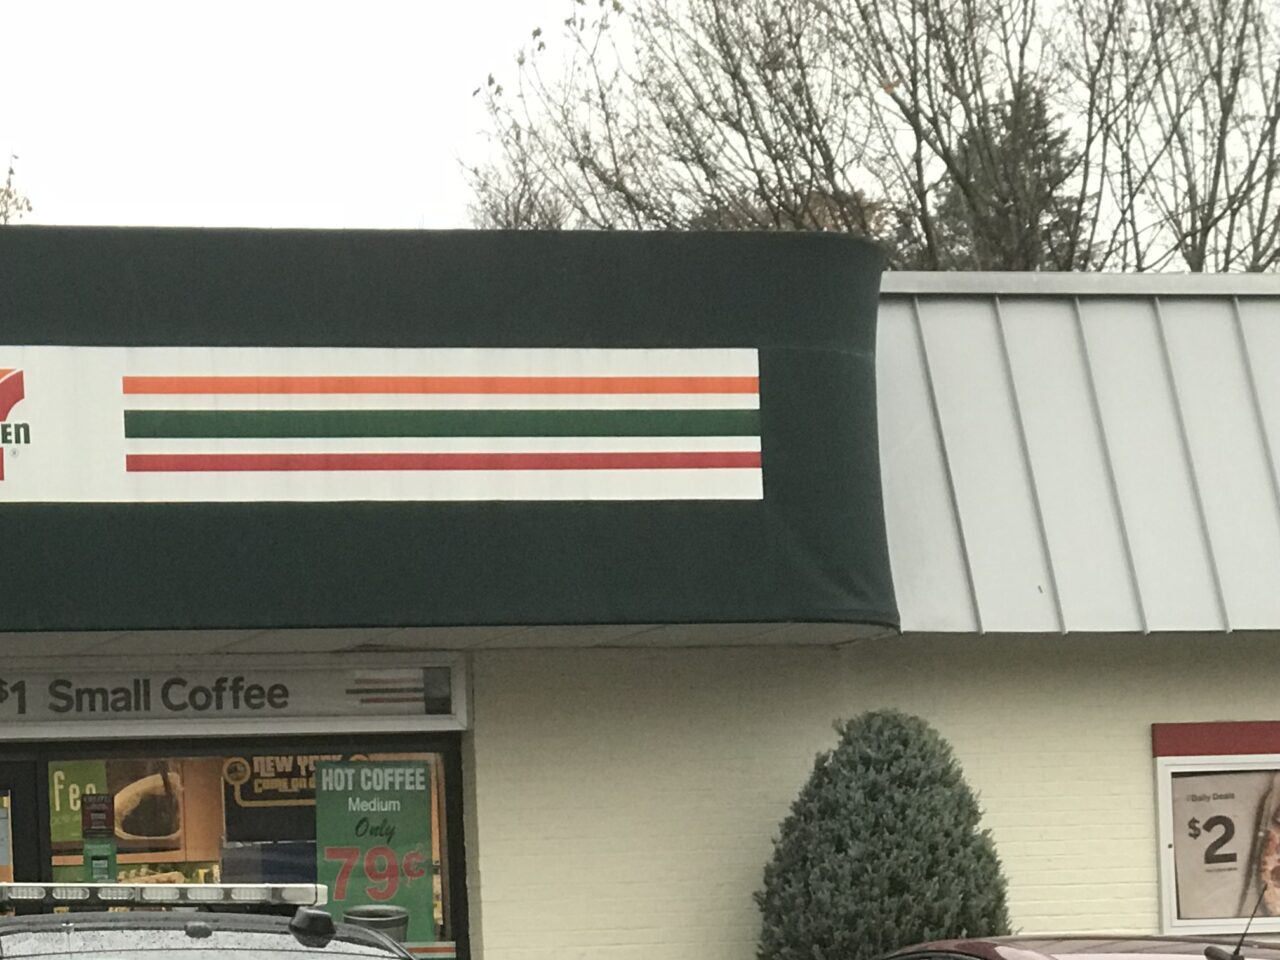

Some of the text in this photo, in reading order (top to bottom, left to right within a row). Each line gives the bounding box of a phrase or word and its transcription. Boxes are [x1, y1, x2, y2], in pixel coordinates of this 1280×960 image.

[48, 678, 151, 714] Small
[160, 676, 290, 712] Coffee
[252, 756, 293, 777] NEW
[321, 767, 356, 792] HOT
[365, 767, 426, 792] COFFEE
[348, 797, 401, 812] Medium
[354, 817, 396, 843] Only
[1187, 814, 1238, 865] $2
